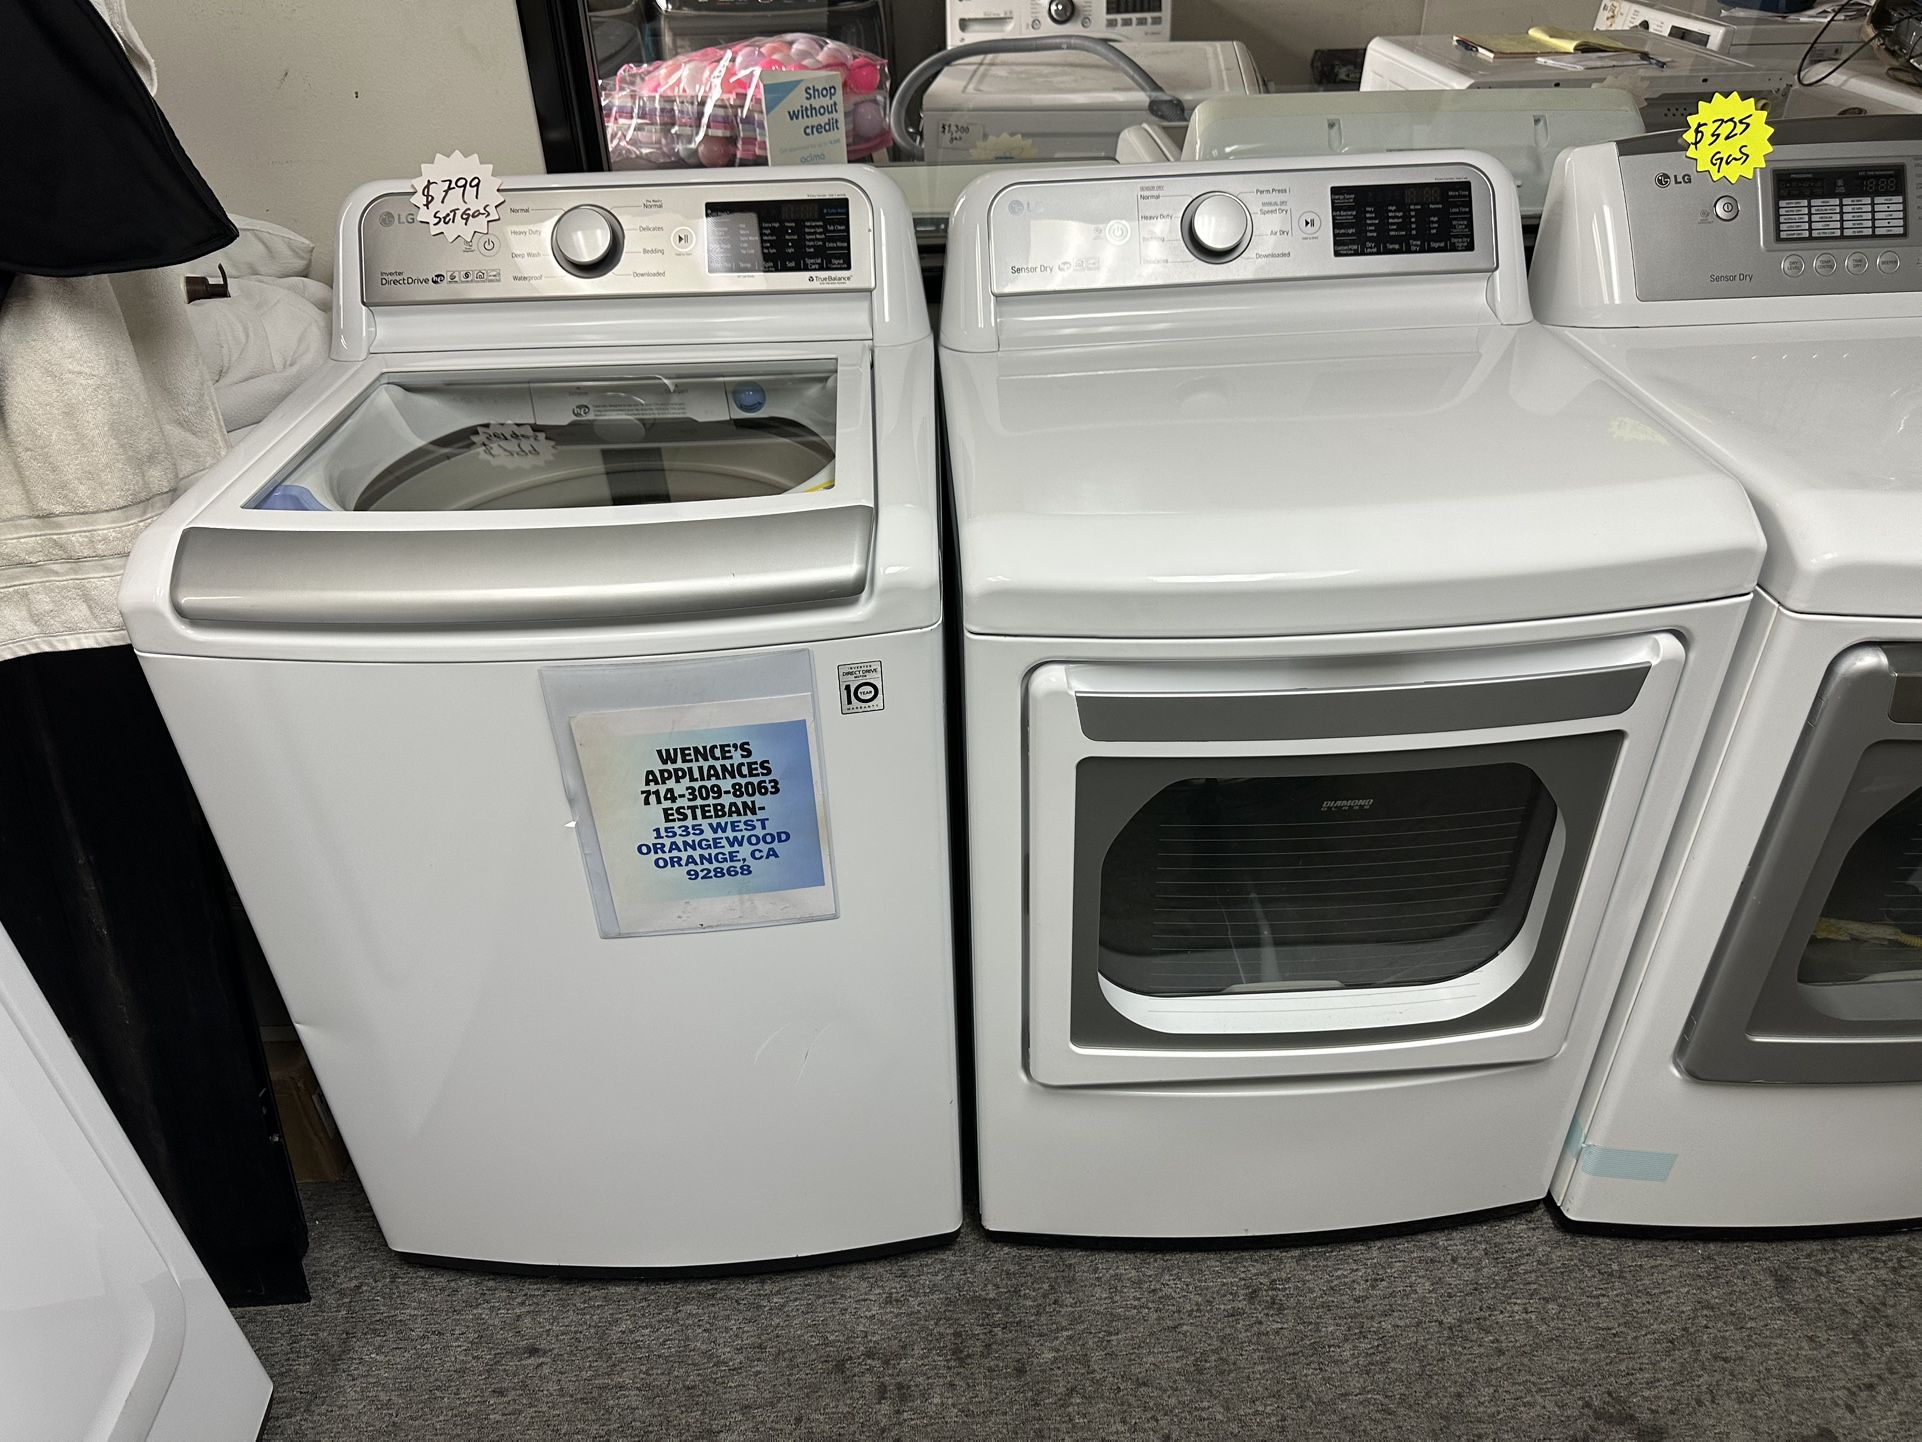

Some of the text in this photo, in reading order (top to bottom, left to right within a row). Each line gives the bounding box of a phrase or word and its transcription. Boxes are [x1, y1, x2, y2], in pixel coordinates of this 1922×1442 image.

[805, 85, 837, 101] Shop
[787, 101, 839, 121] without
[803, 117, 840, 136] credit
[1690, 114, 1753, 151] $325
[1674, 174, 1692, 185] LG
[422, 176, 482, 210] $799
[398, 213, 415, 225] LG
[509, 206, 530, 214] Normal
[1256, 251, 1291, 259] Downloaded
[512, 274, 543, 282] Waterproof
[1011, 264, 1054, 274] Sensor Dry
[1709, 273, 1753, 282] Sensor Dry
[842, 669, 861, 677] DIRECT
[844, 681, 879, 706] 10
[656, 740, 753, 766] WENCE'S
[644, 759, 773, 787] APPLIANCES
[640, 779, 781, 806] 714-309-8063
[661, 800, 766, 824] ESTEBAN-
[1321, 799, 1374, 807] DIAMOND
[652, 818, 770, 840] 1535 WEST
[636, 830, 792, 857] ORANGEWOOD
[653, 847, 780, 870] ORANGE, CA
[685, 864, 753, 881] 92868
